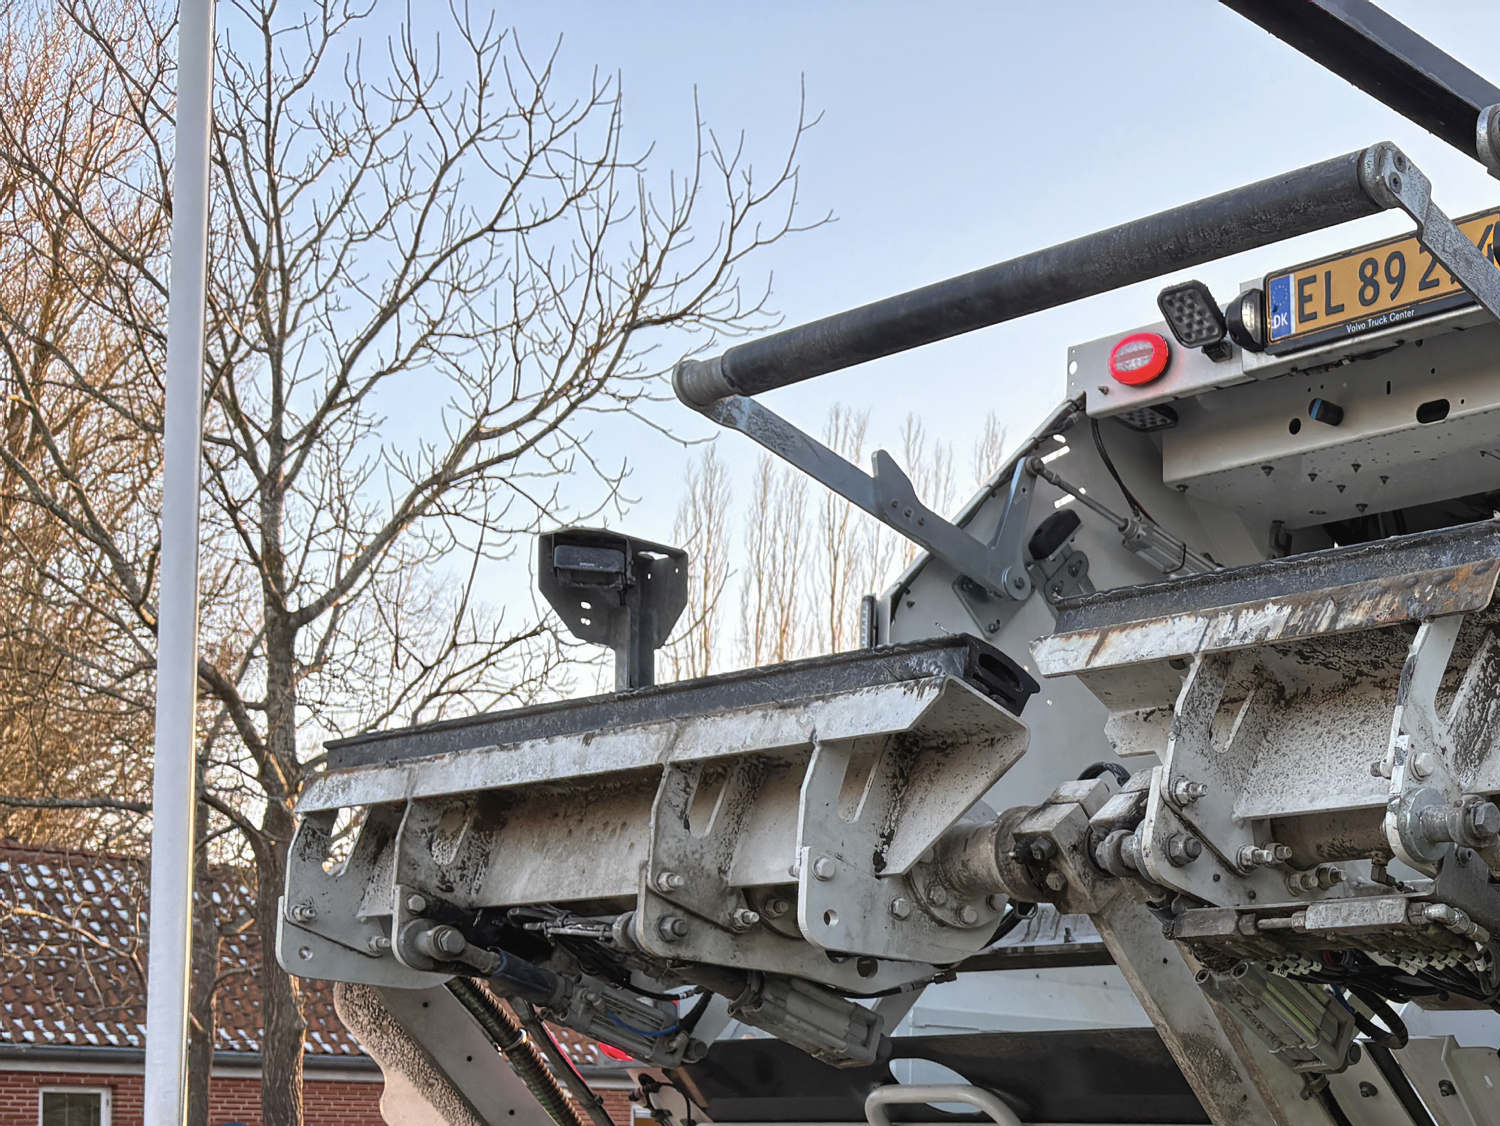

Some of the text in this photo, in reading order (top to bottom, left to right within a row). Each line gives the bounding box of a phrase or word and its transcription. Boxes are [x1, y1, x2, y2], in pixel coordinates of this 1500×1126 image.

[1298, 270, 1344, 323] EL
[1358, 250, 1406, 307] 89
[1273, 312, 1288, 329] DK
[1346, 309, 1415, 333] Volvo Truck Center
